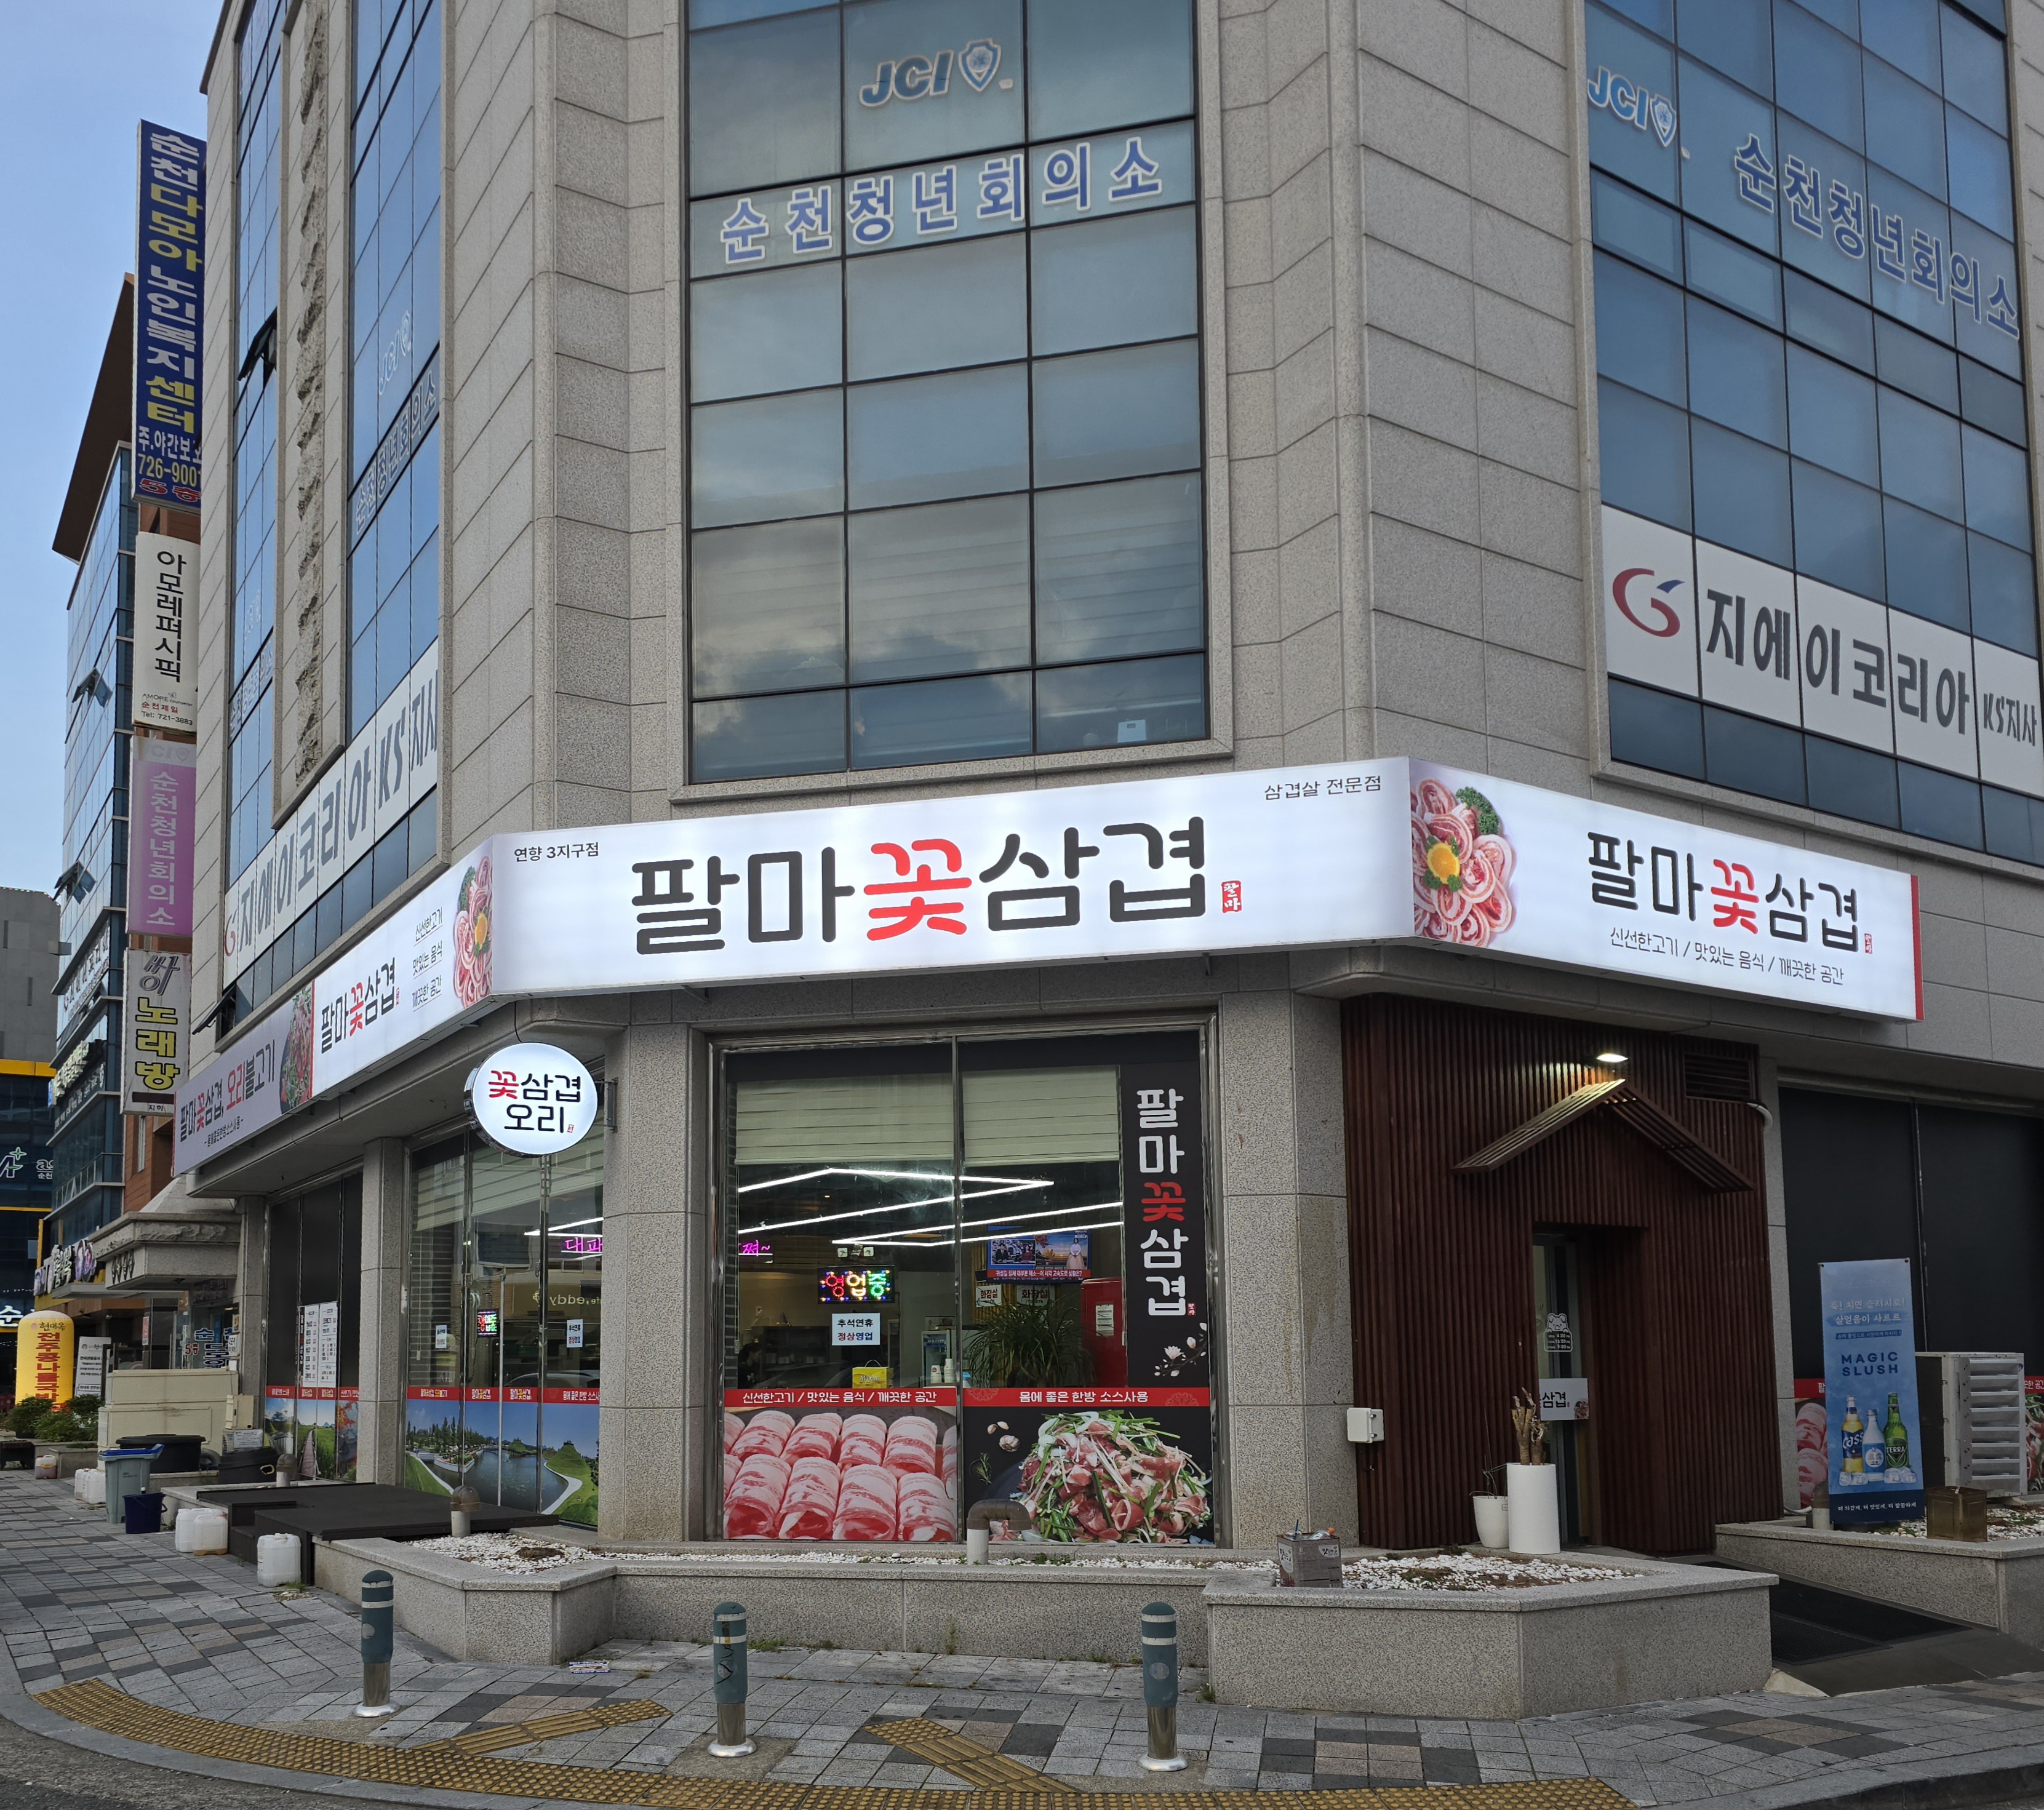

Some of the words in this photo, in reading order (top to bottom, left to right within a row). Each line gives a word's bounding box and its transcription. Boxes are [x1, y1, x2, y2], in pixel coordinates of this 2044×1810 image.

[860, 49, 954, 106] JCI
[1587, 65, 1648, 130] JCI
[721, 136, 1162, 264] 순천청년회의소
[1734, 132, 2021, 340] 순천청년회의소
[356, 368, 437, 536] 순천청년회의소
[155, 551, 186, 684] 아모레퍼시픽
[1705, 588, 1971, 736] 지에이코리아
[1263, 783, 1321, 801] 삼겹살
[1326, 775, 1381, 795] 전문점
[146, 770, 179, 927] 순천청년회의소
[238, 743, 372, 953] 지에이코리아
[514, 846, 543, 863] 연향
[546, 842, 600, 860] 3지구점
[631, 816, 1205, 955] 팔마꽃삼겹
[1587, 831, 1858, 953] 팔마꽃삼겹
[1610, 927, 1679, 957] 신선한고기
[1695, 942, 1735, 967] 맛있는
[1739, 951, 1765, 973] 음식
[1779, 955, 1817, 981] 깨끗한
[1821, 965, 1845, 986] 공간
[321, 957, 396, 1055] 팔마꽃삼겹
[135, 997, 180, 1090] 노래방
[226, 1039, 275, 1111] 오리불고기
[489, 1070, 581, 1103] 꽃삼겹
[504, 1104, 564, 1134] 오리
[1136, 1088, 1189, 1316] 팔마꽃삼겹
[825, 1273, 886, 1298] 영업중
[837, 1318, 873, 1328] 추석연휴
[837, 1332, 873, 1341] 정상영업
[1835, 1314, 1870, 1325] 살얼음이
[1874, 1313, 1901, 1323] 사르르
[1842, 1352, 1898, 1364] MAGIC
[1842, 1365, 1898, 1376] SLUSH
[743, 1392, 794, 1404] 신선한고기
[807, 1392, 839, 1403] 맛있는
[843, 1392, 864, 1403] 음식
[878, 1392, 912, 1403] 깨끗한
[914, 1392, 937, 1403] 공간
[1019, 1392, 1042, 1403] 몸에
[1045, 1391, 1069, 1403] 좋은
[1071, 1391, 1096, 1403] 한방
[1100, 1391, 1149, 1403] 소스사용
[1539, 1392, 1566, 1408] 삼겹
